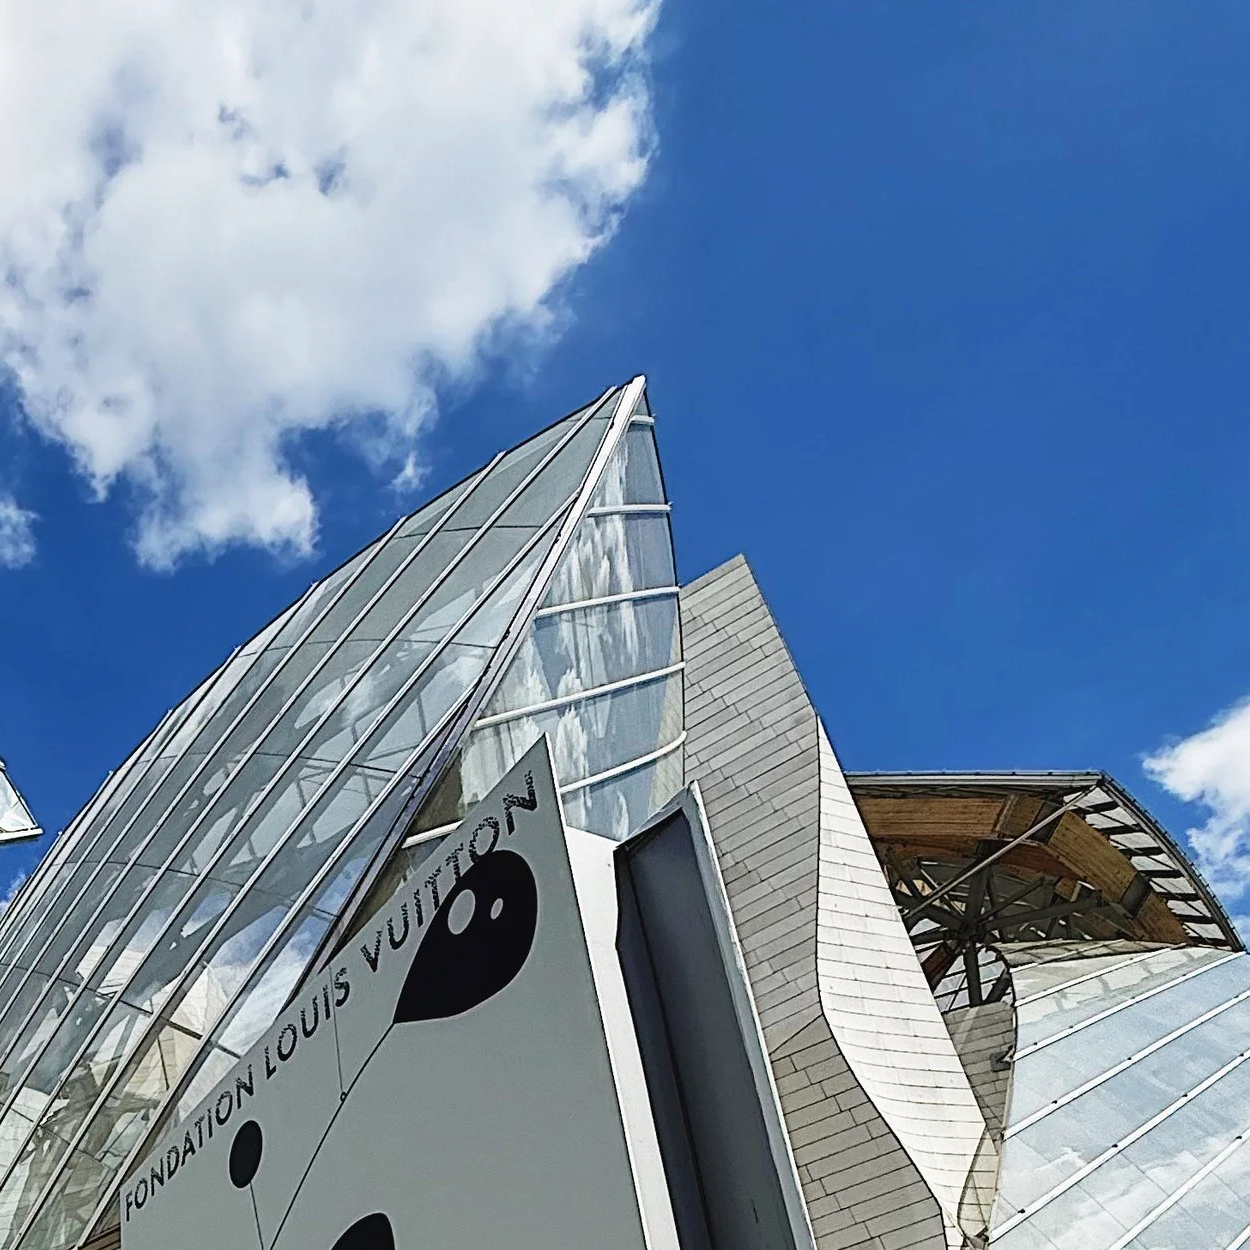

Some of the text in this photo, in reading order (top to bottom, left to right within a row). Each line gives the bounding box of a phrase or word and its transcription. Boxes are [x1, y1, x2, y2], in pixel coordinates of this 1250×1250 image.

[125, 770, 538, 1222] FONDATION LOUIS VUITTON
